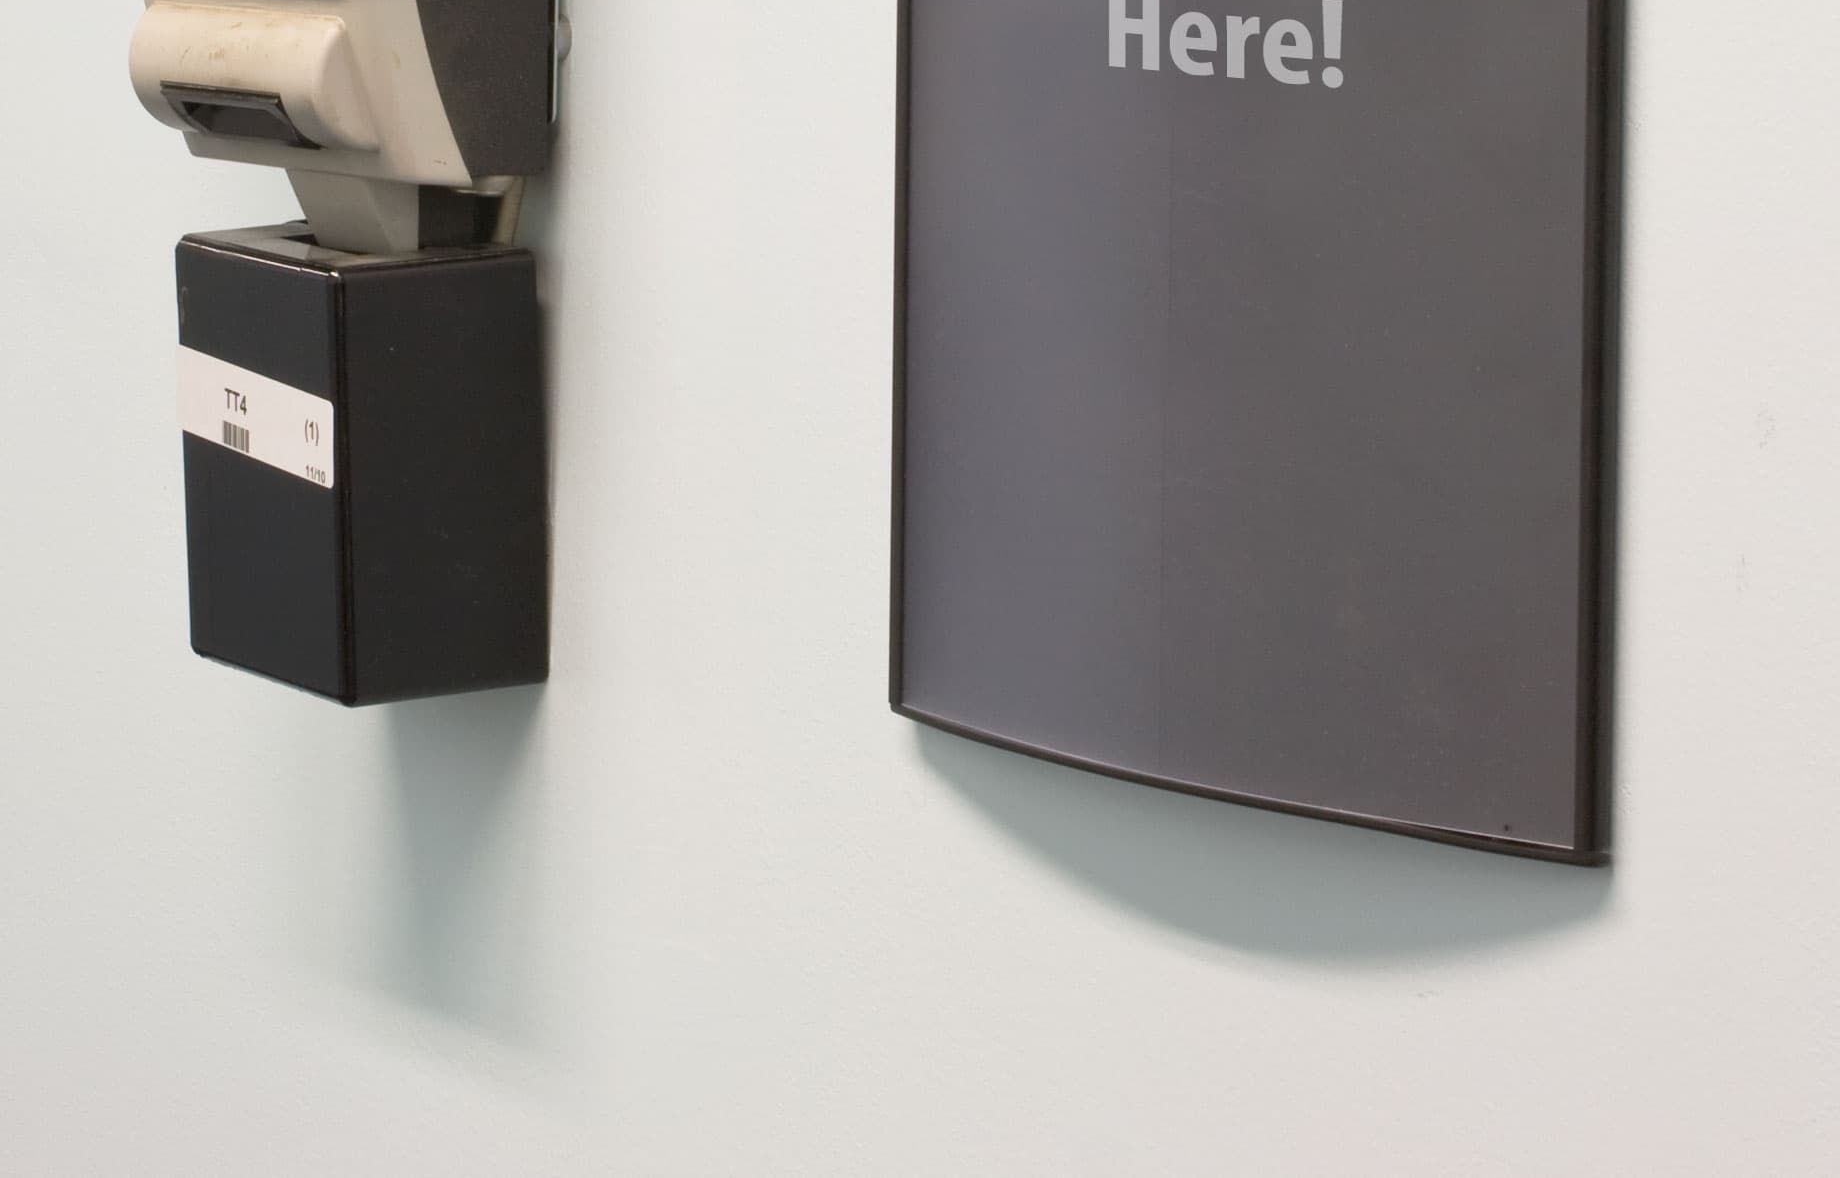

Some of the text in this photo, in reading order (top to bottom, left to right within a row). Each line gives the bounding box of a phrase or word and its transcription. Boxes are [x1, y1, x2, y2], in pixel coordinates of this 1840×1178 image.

[224, 388, 248, 415] TT4
[304, 419, 320, 446] (1)
[305, 465, 327, 484] 11/10
